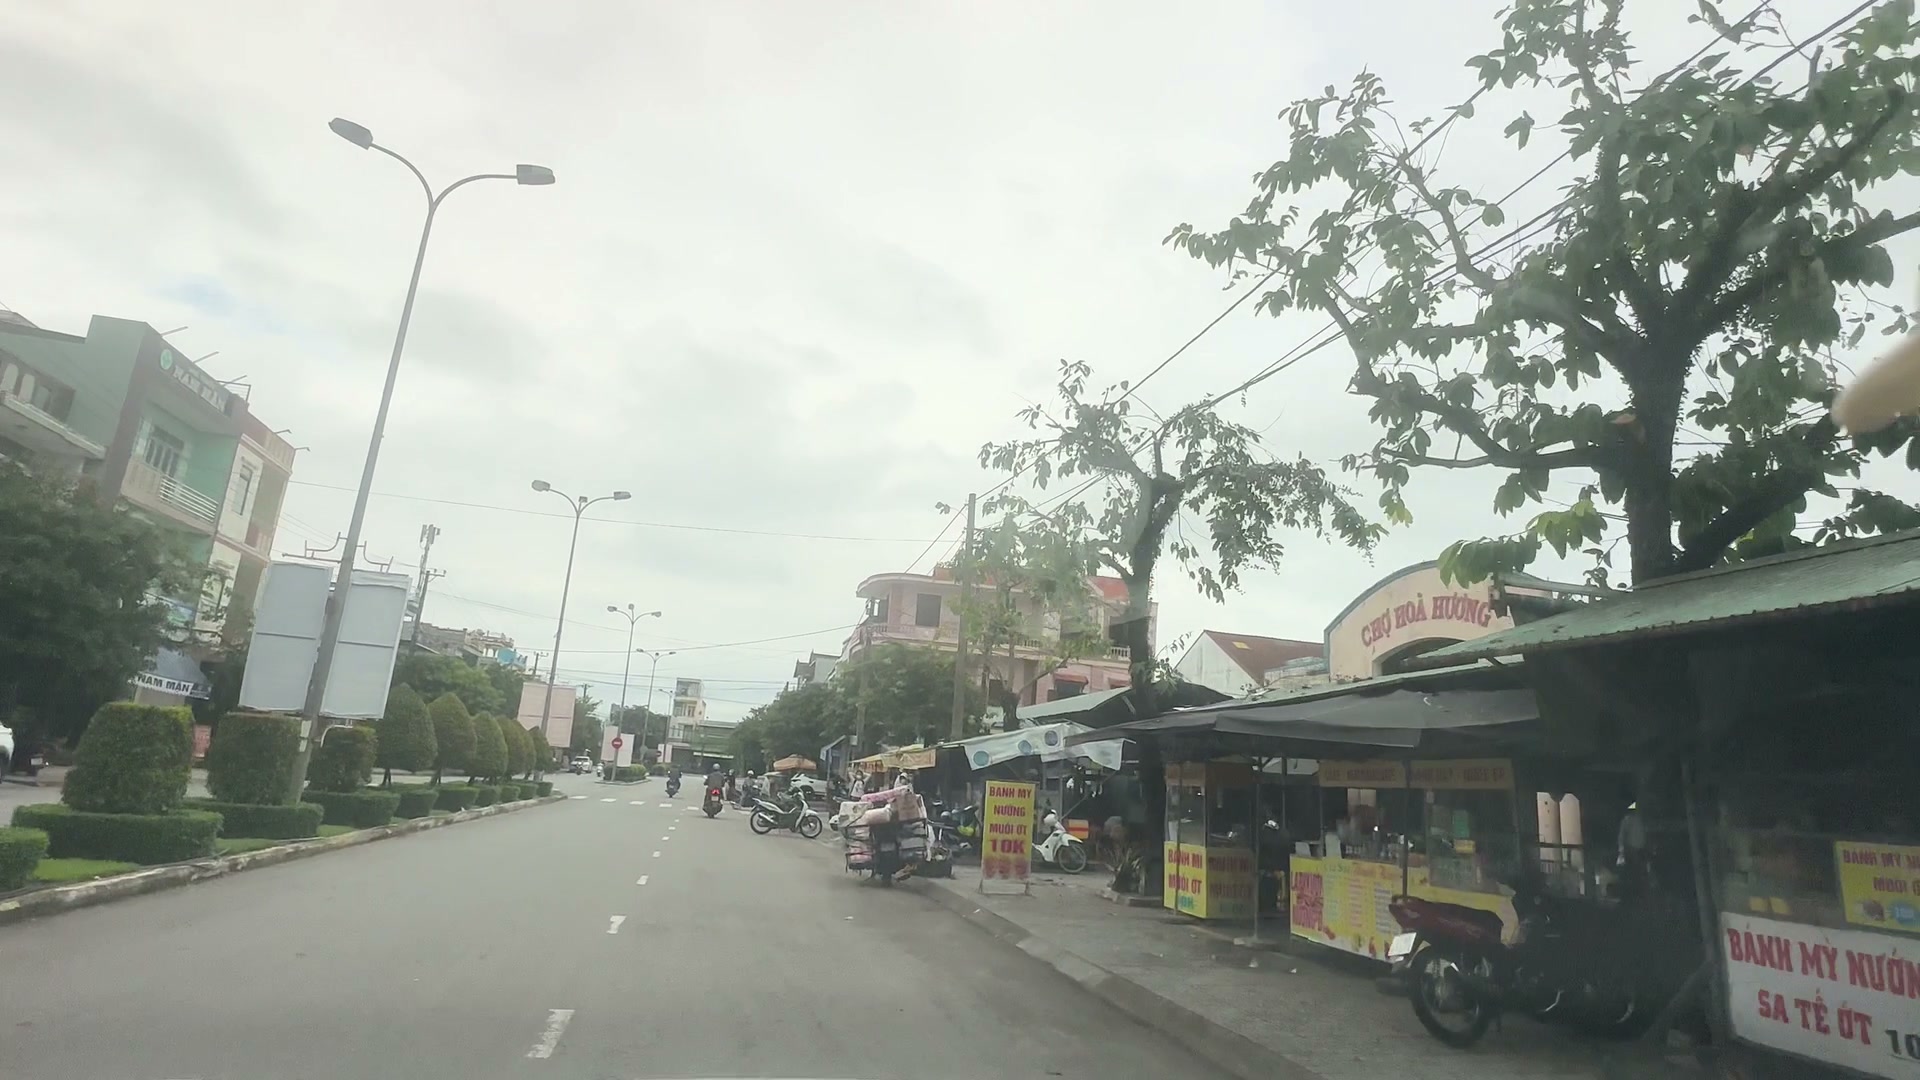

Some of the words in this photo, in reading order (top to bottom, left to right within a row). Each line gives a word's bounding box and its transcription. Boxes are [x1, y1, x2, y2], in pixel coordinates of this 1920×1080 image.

[1361, 608, 1391, 647] CHỢ
[989, 839, 1025, 854] 10K
[1727, 922, 1793, 972] BÁNH
[1758, 988, 1789, 1024] SA
[1794, 988, 1831, 1035] TẾ
